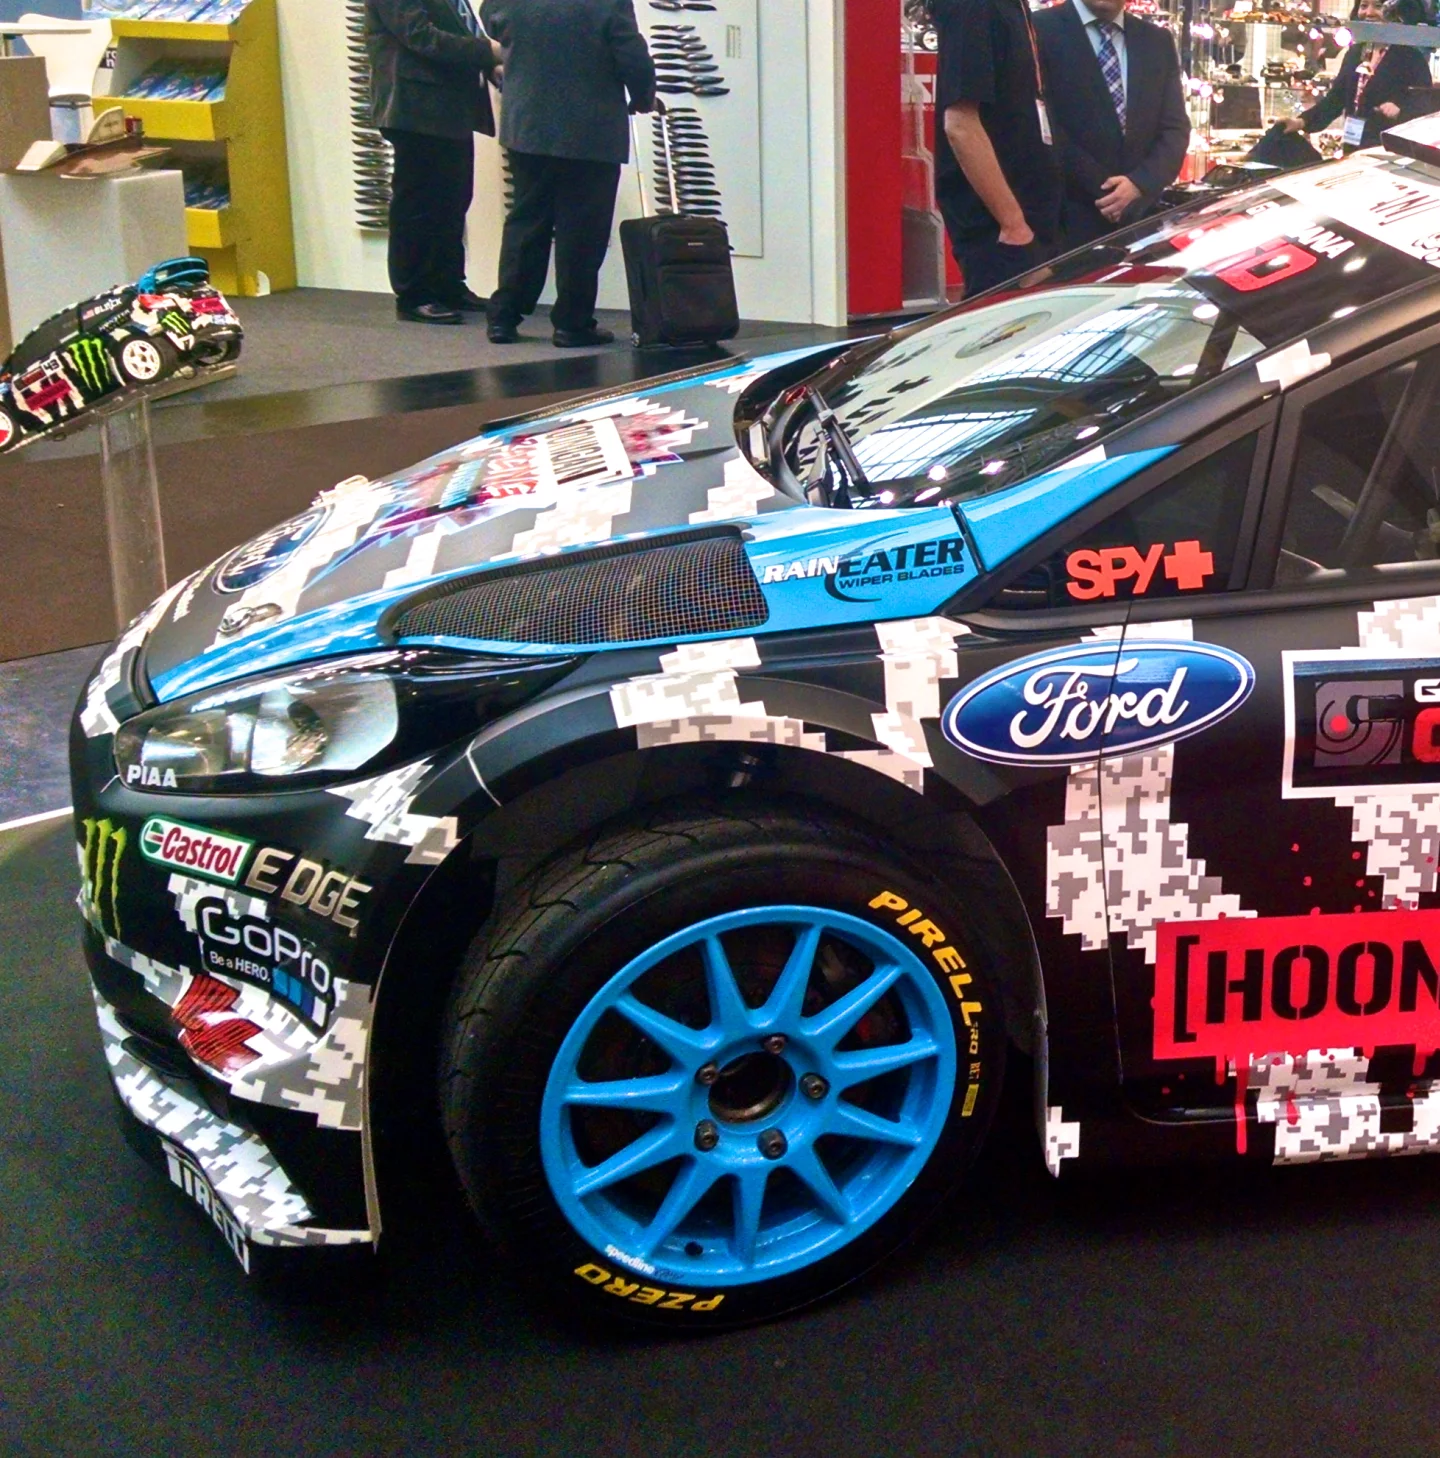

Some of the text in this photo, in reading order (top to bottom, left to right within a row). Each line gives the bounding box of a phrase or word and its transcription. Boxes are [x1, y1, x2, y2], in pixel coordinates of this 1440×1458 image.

[838, 562, 966, 591] WIPER BLADES
[1008, 656, 1191, 749] Ford
[126, 763, 179, 789] PIAA
[161, 826, 374, 930] Castrol EDGE
[201, 906, 331, 994] GoPro
[209, 950, 226, 967] Be
